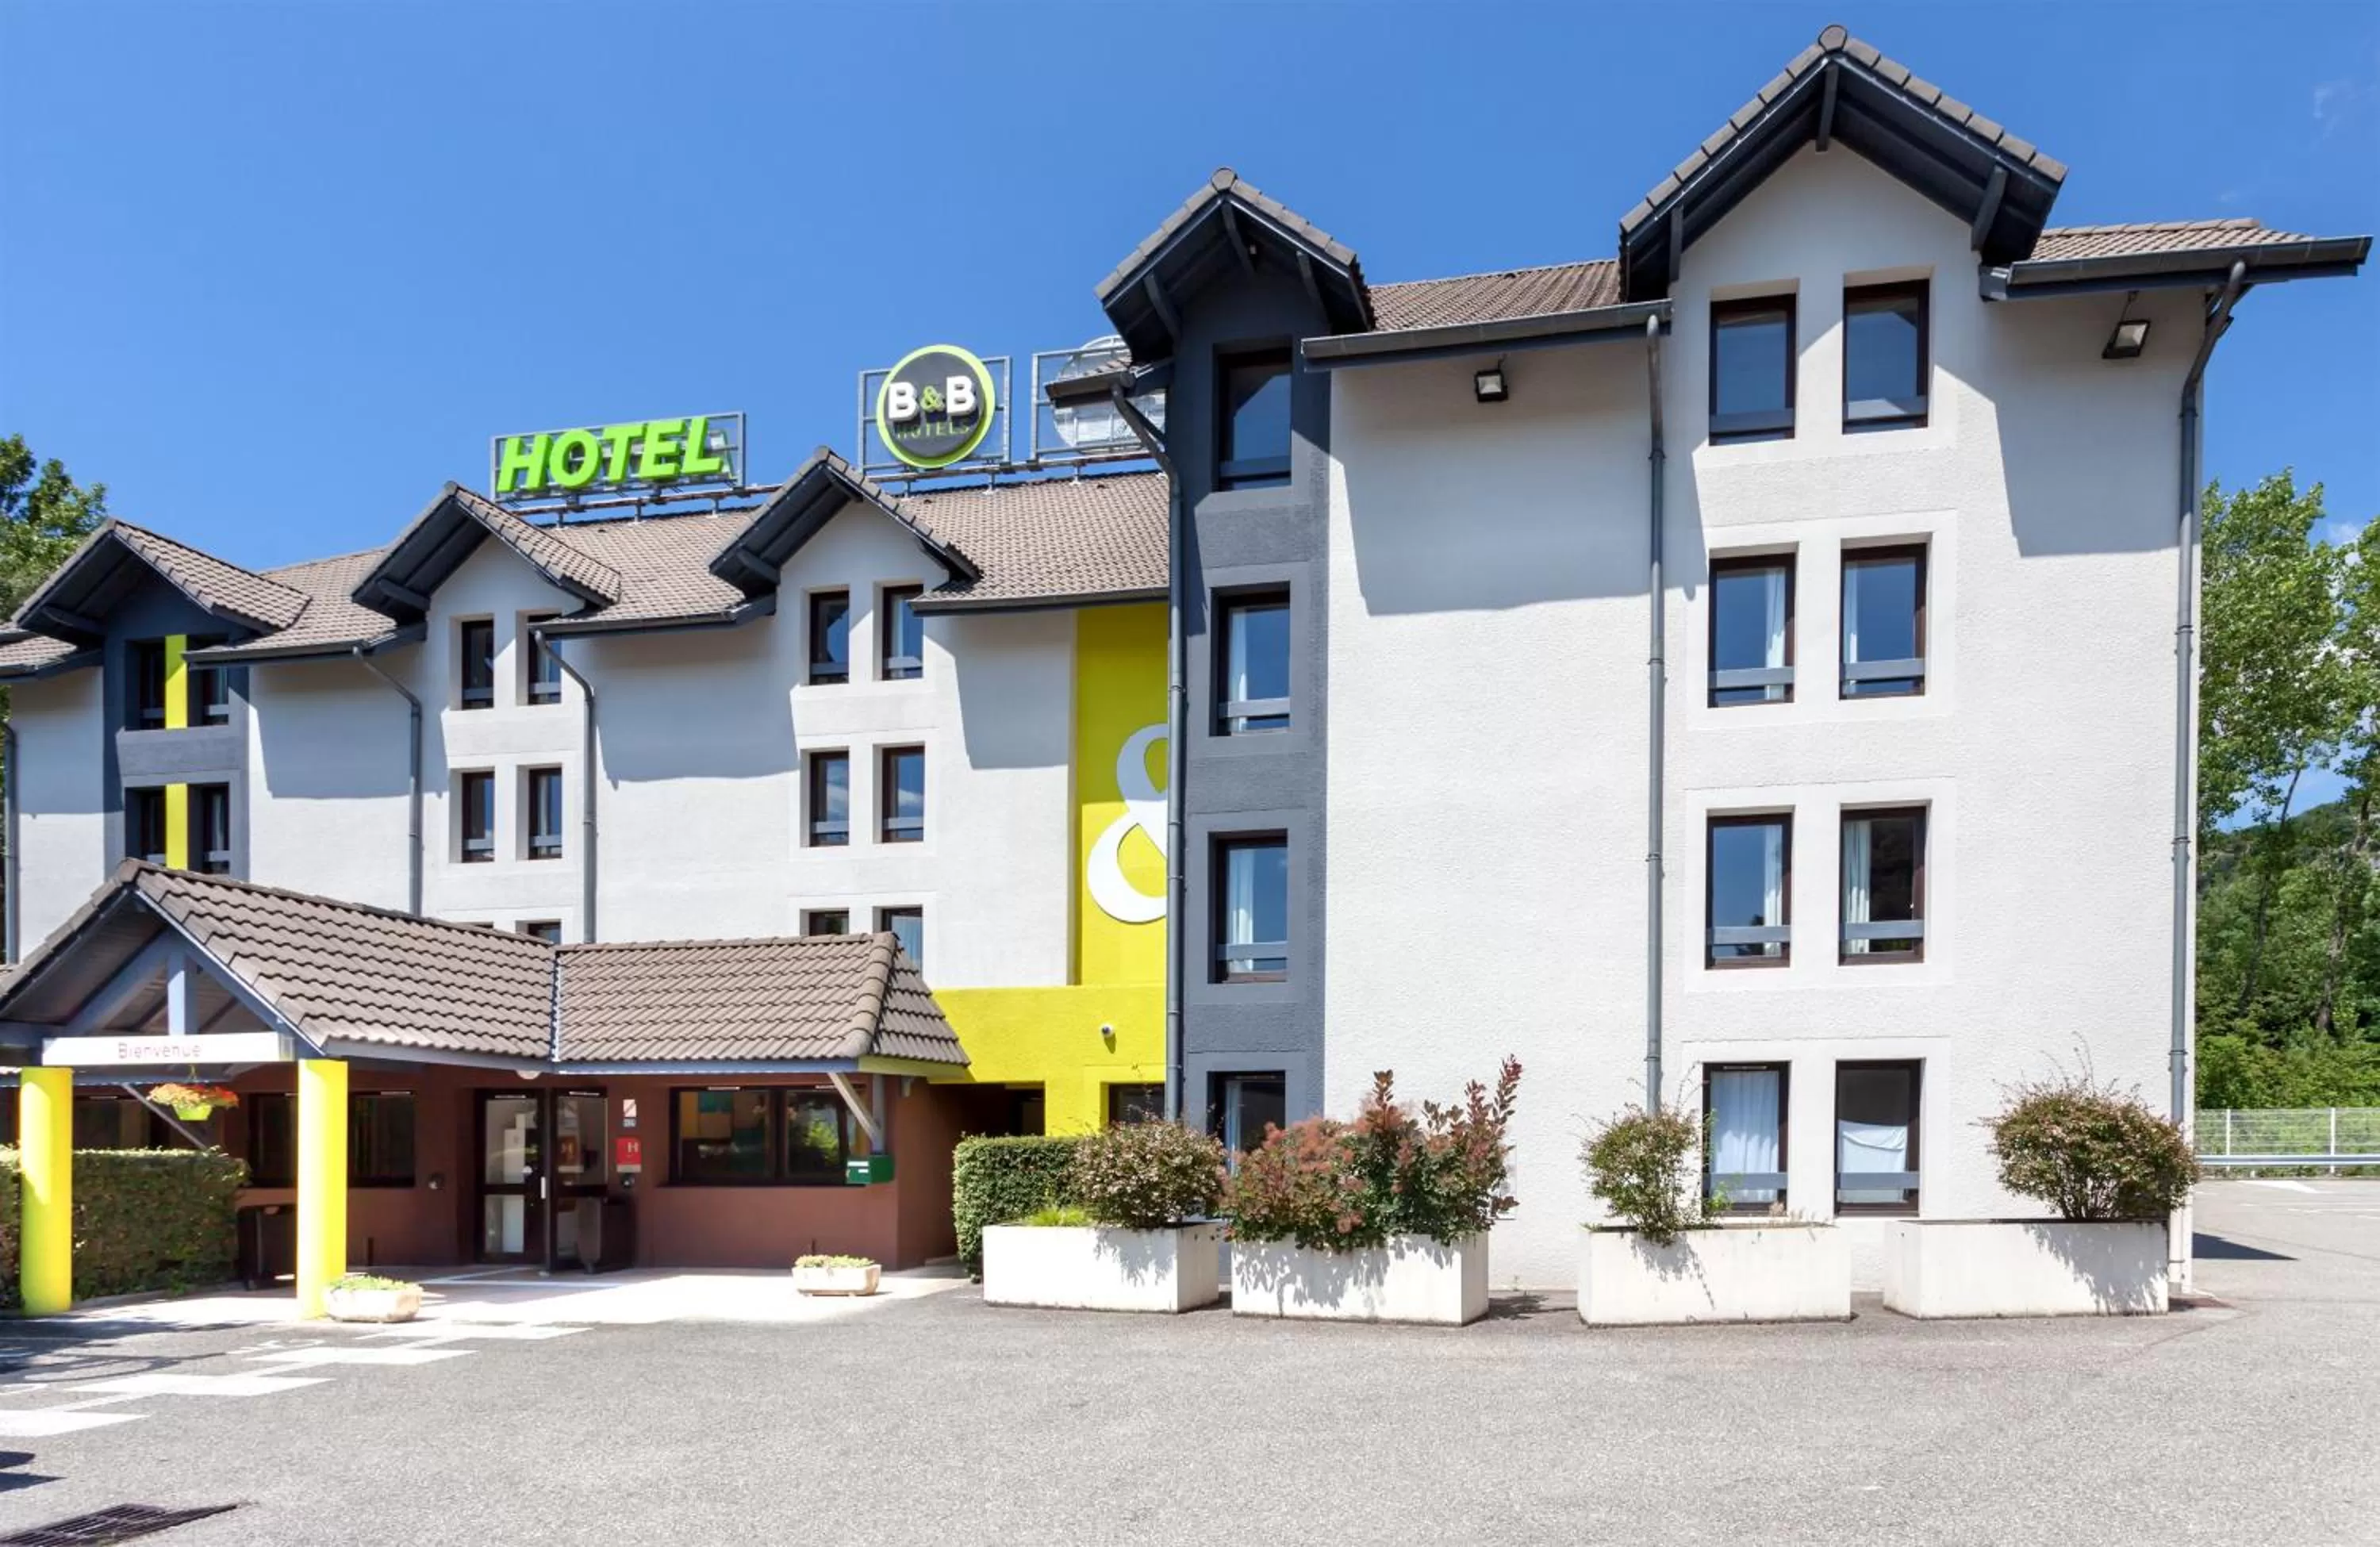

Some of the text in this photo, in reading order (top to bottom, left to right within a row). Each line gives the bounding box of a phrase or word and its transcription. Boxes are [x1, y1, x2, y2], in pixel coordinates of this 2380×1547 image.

[889, 375, 976, 420] B&B
[497, 416, 723, 492] HOTEL
[117, 1042, 201, 1059] Bienvenue
